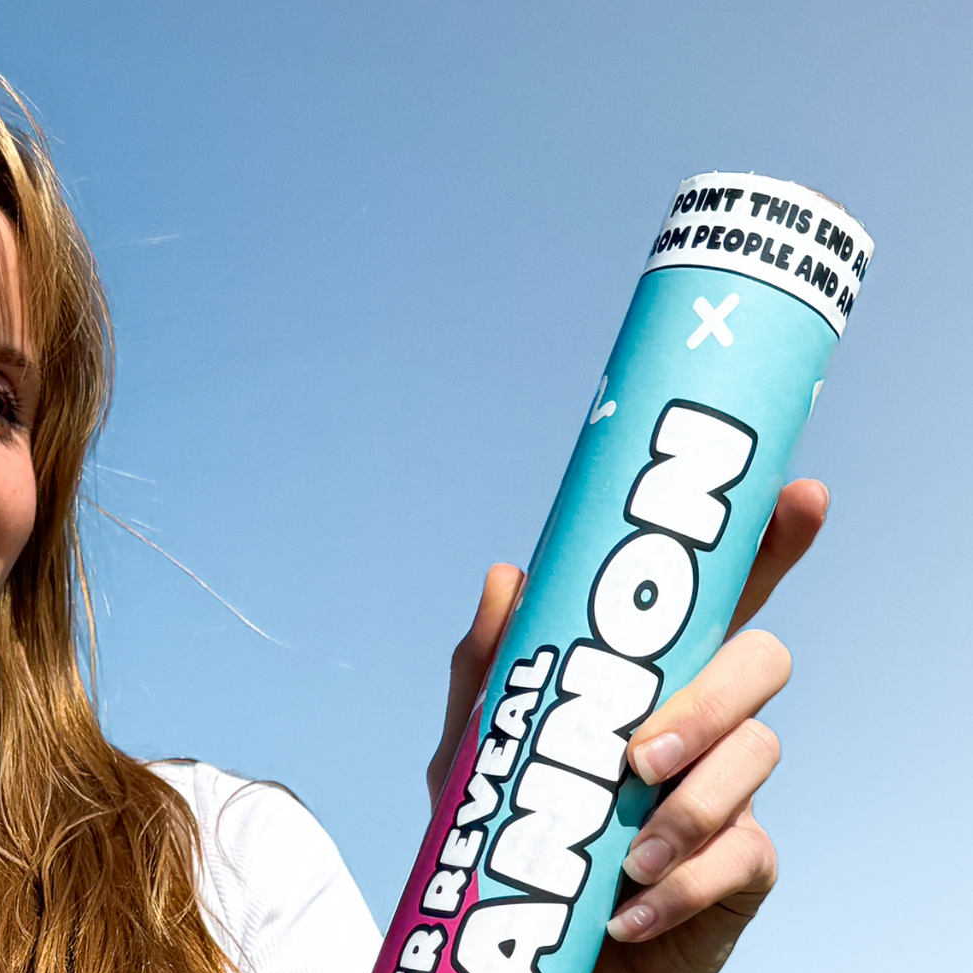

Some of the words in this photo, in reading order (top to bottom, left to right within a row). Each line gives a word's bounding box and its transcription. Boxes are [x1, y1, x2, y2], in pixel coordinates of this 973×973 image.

[670, 187, 745, 218] POINT
[749, 191, 813, 235] THIS
[814, 217, 854, 263] END
[691, 224, 795, 271] PEOPLE
[794, 254, 839, 298] AND
[420, 645, 559, 917] REVEAL
